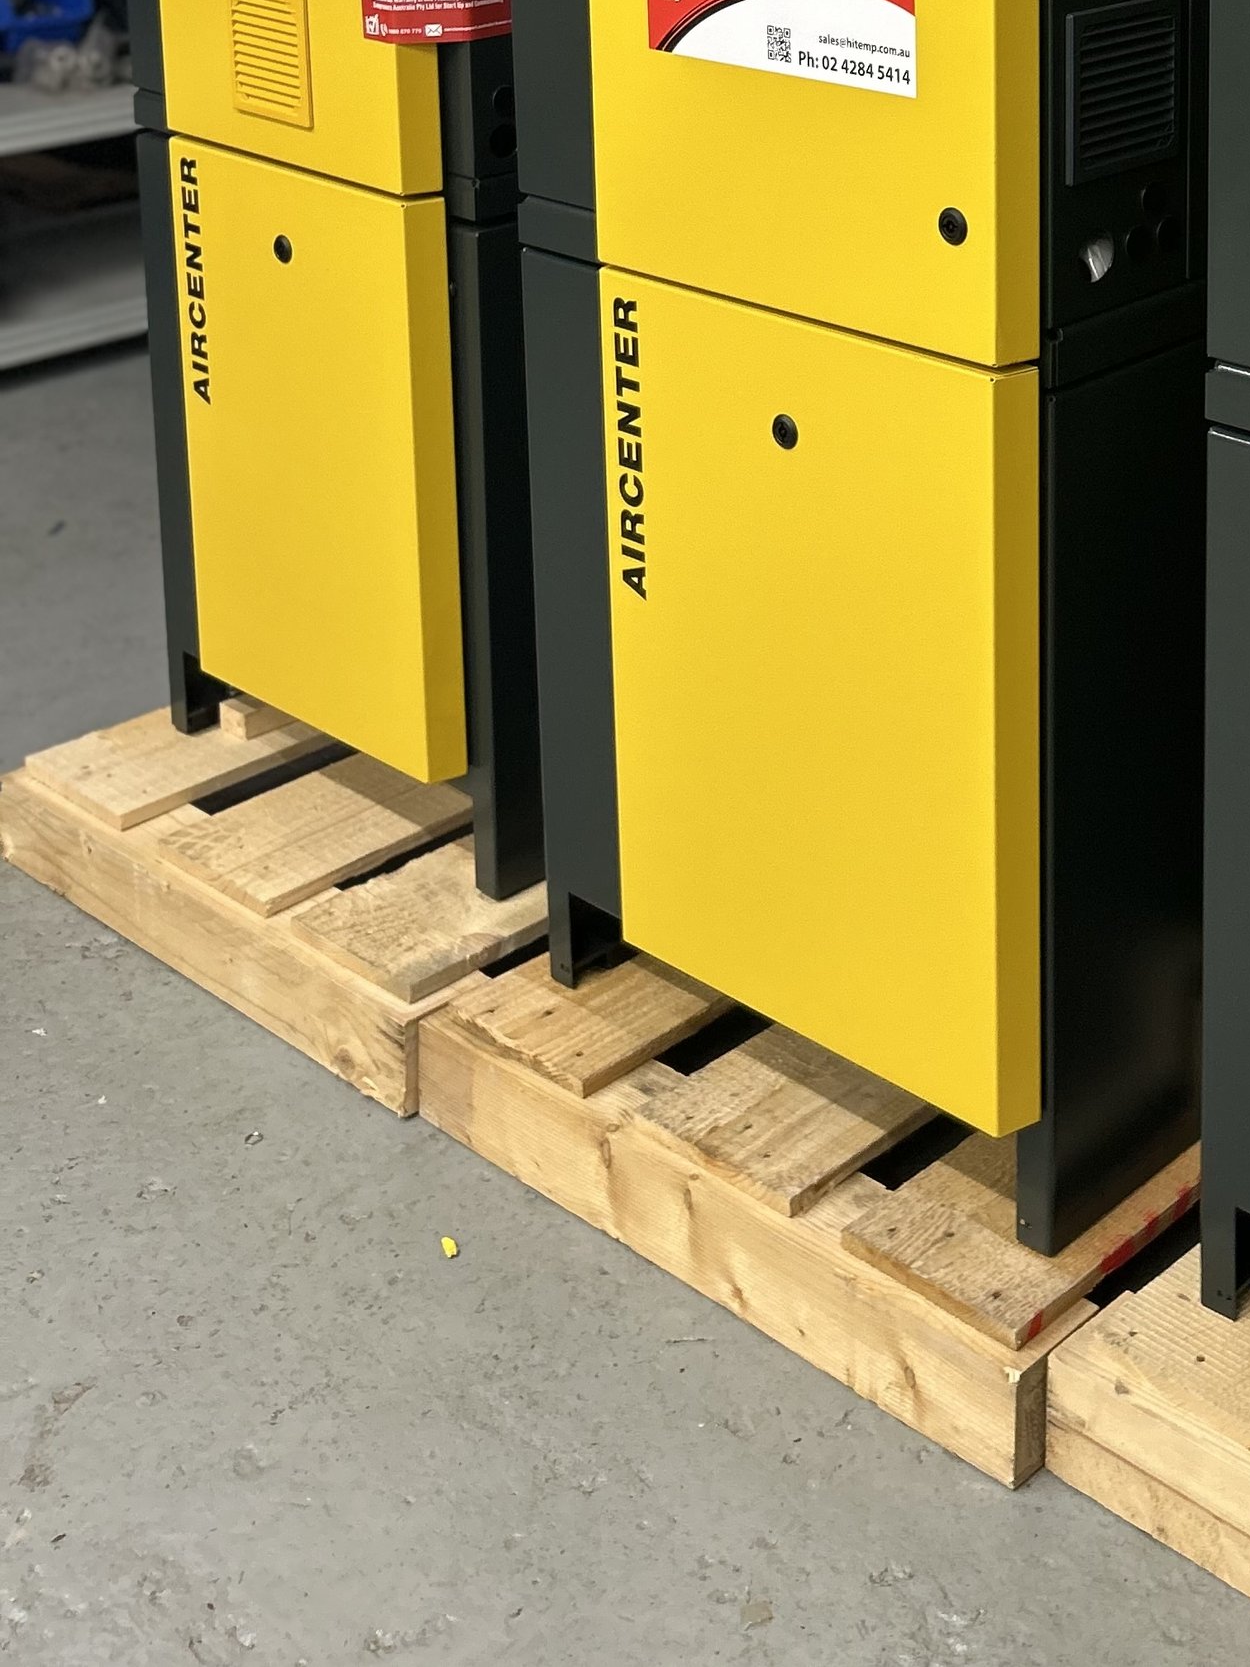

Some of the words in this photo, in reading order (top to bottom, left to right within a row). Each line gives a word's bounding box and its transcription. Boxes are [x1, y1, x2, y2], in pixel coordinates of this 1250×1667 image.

[798, 51, 819, 69] Ph:
[822, 56, 838, 72] 02
[841, 59, 874, 78] 4284
[877, 65, 911, 85] 5414
[818, 34, 911, 58] sales@hitemp.com.au
[180, 156, 211, 406] AIRCENTER
[613, 296, 647, 601] AIRCENTER
